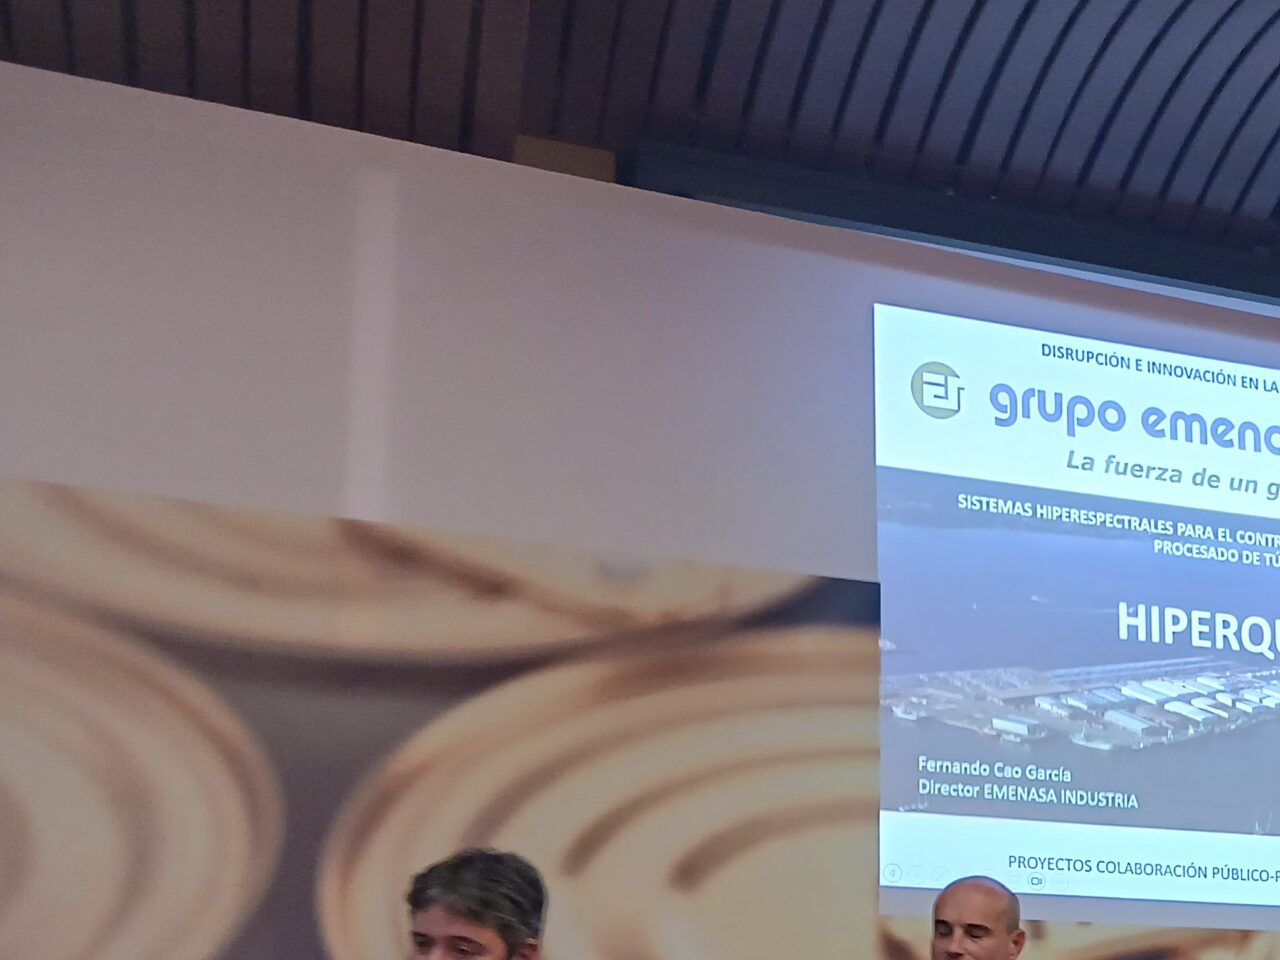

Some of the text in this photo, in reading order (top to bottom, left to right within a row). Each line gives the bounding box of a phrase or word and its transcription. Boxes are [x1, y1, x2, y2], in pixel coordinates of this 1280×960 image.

[1041, 343, 1131, 370] DISRUPCIÓN
[1147, 361, 1237, 386] INNOVACIÓN
[1241, 376, 1259, 390] EN
[1263, 379, 1279, 394] LA
[989, 383, 1126, 437] grupo
[1066, 450, 1094, 471] La
[1104, 454, 1183, 484] fuerza
[1191, 467, 1221, 489] de
[1229, 477, 1258, 494] un
[958, 493, 1032, 517] SISTEMAS
[1036, 504, 1174, 535] HIPERESPECTRALES
[1177, 522, 1214, 541] PARA
[1218, 527, 1233, 543] EL
[1154, 538, 1238, 563] PROCESADO
[1242, 551, 1261, 565] DE
[918, 755, 1071, 782] Fernando Cao García
[919, 778, 1138, 809] Director EMENASA INDUSTRIA
[1009, 855, 1092, 873] PROYECTOS
[1096, 860, 1207, 879] COLABORACIÓN
